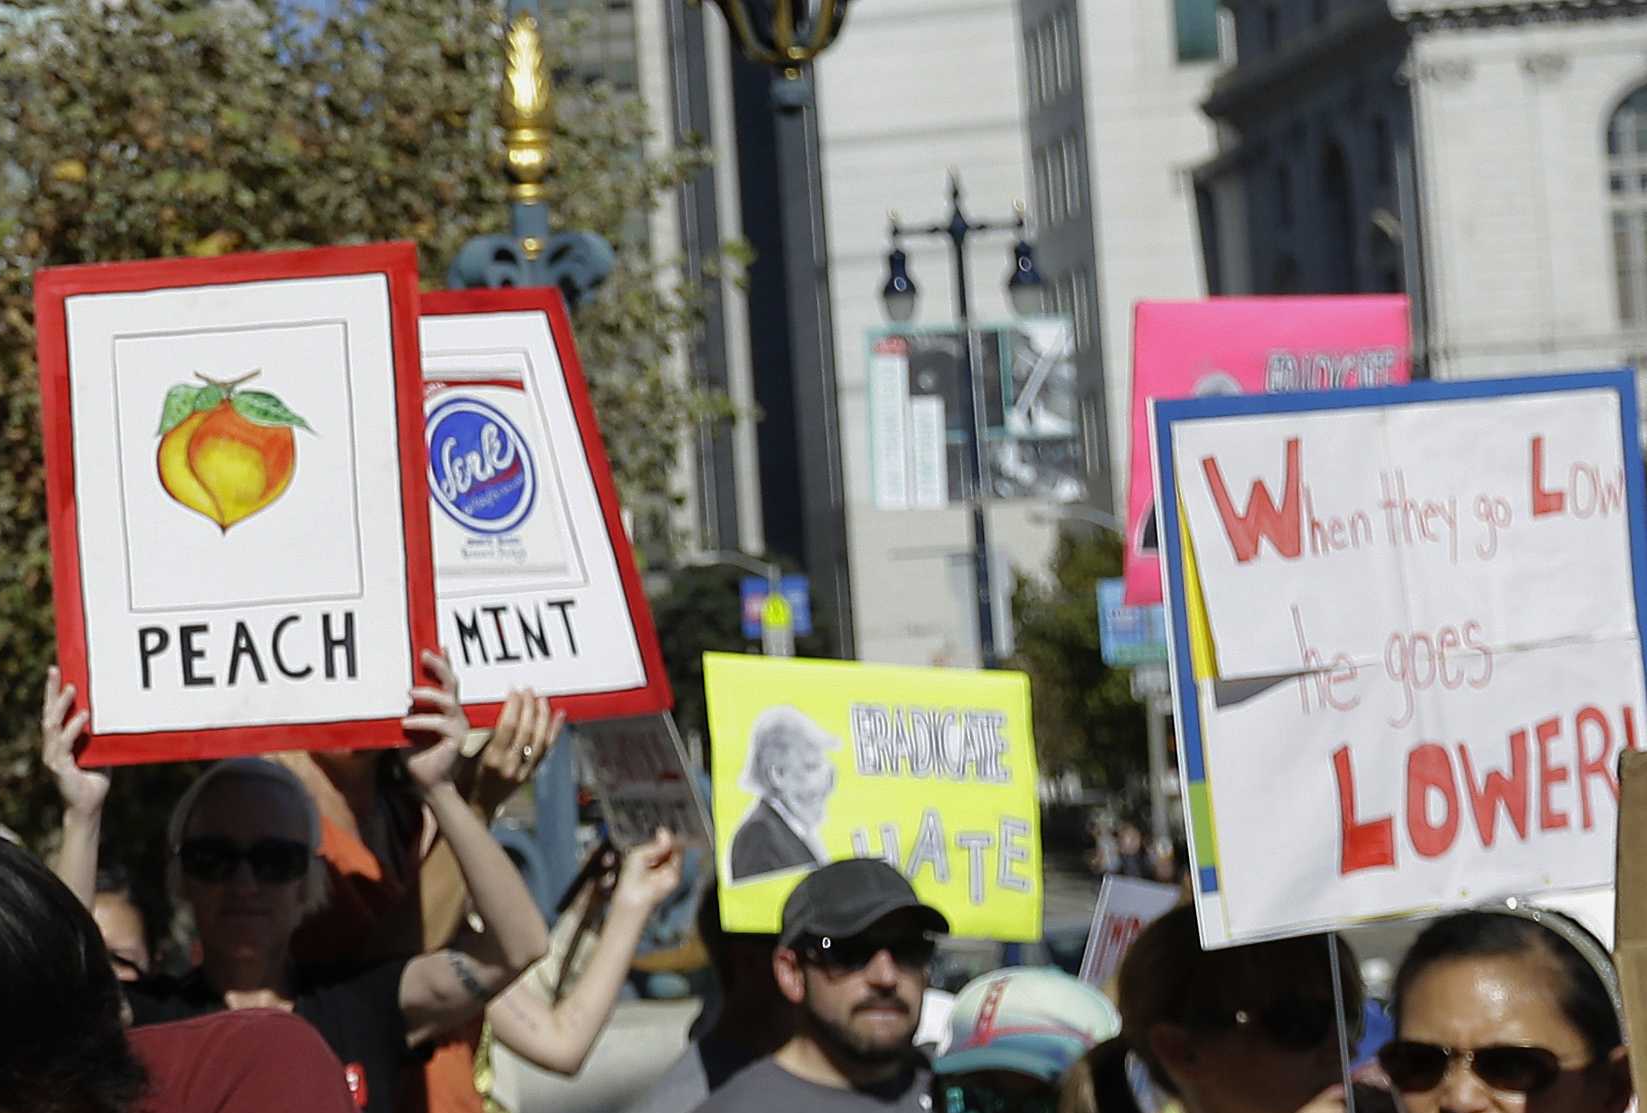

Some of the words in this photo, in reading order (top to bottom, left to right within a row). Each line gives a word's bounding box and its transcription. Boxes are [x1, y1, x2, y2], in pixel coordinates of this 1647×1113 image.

[1200, 436, 1373, 564] When
[1379, 468, 1458, 563] they
[1473, 494, 1512, 561] go
[138, 611, 360, 691] PEACH
[455, 598, 581, 667] MINT
[1290, 603, 1361, 716] he
[1384, 619, 1494, 729] goes
